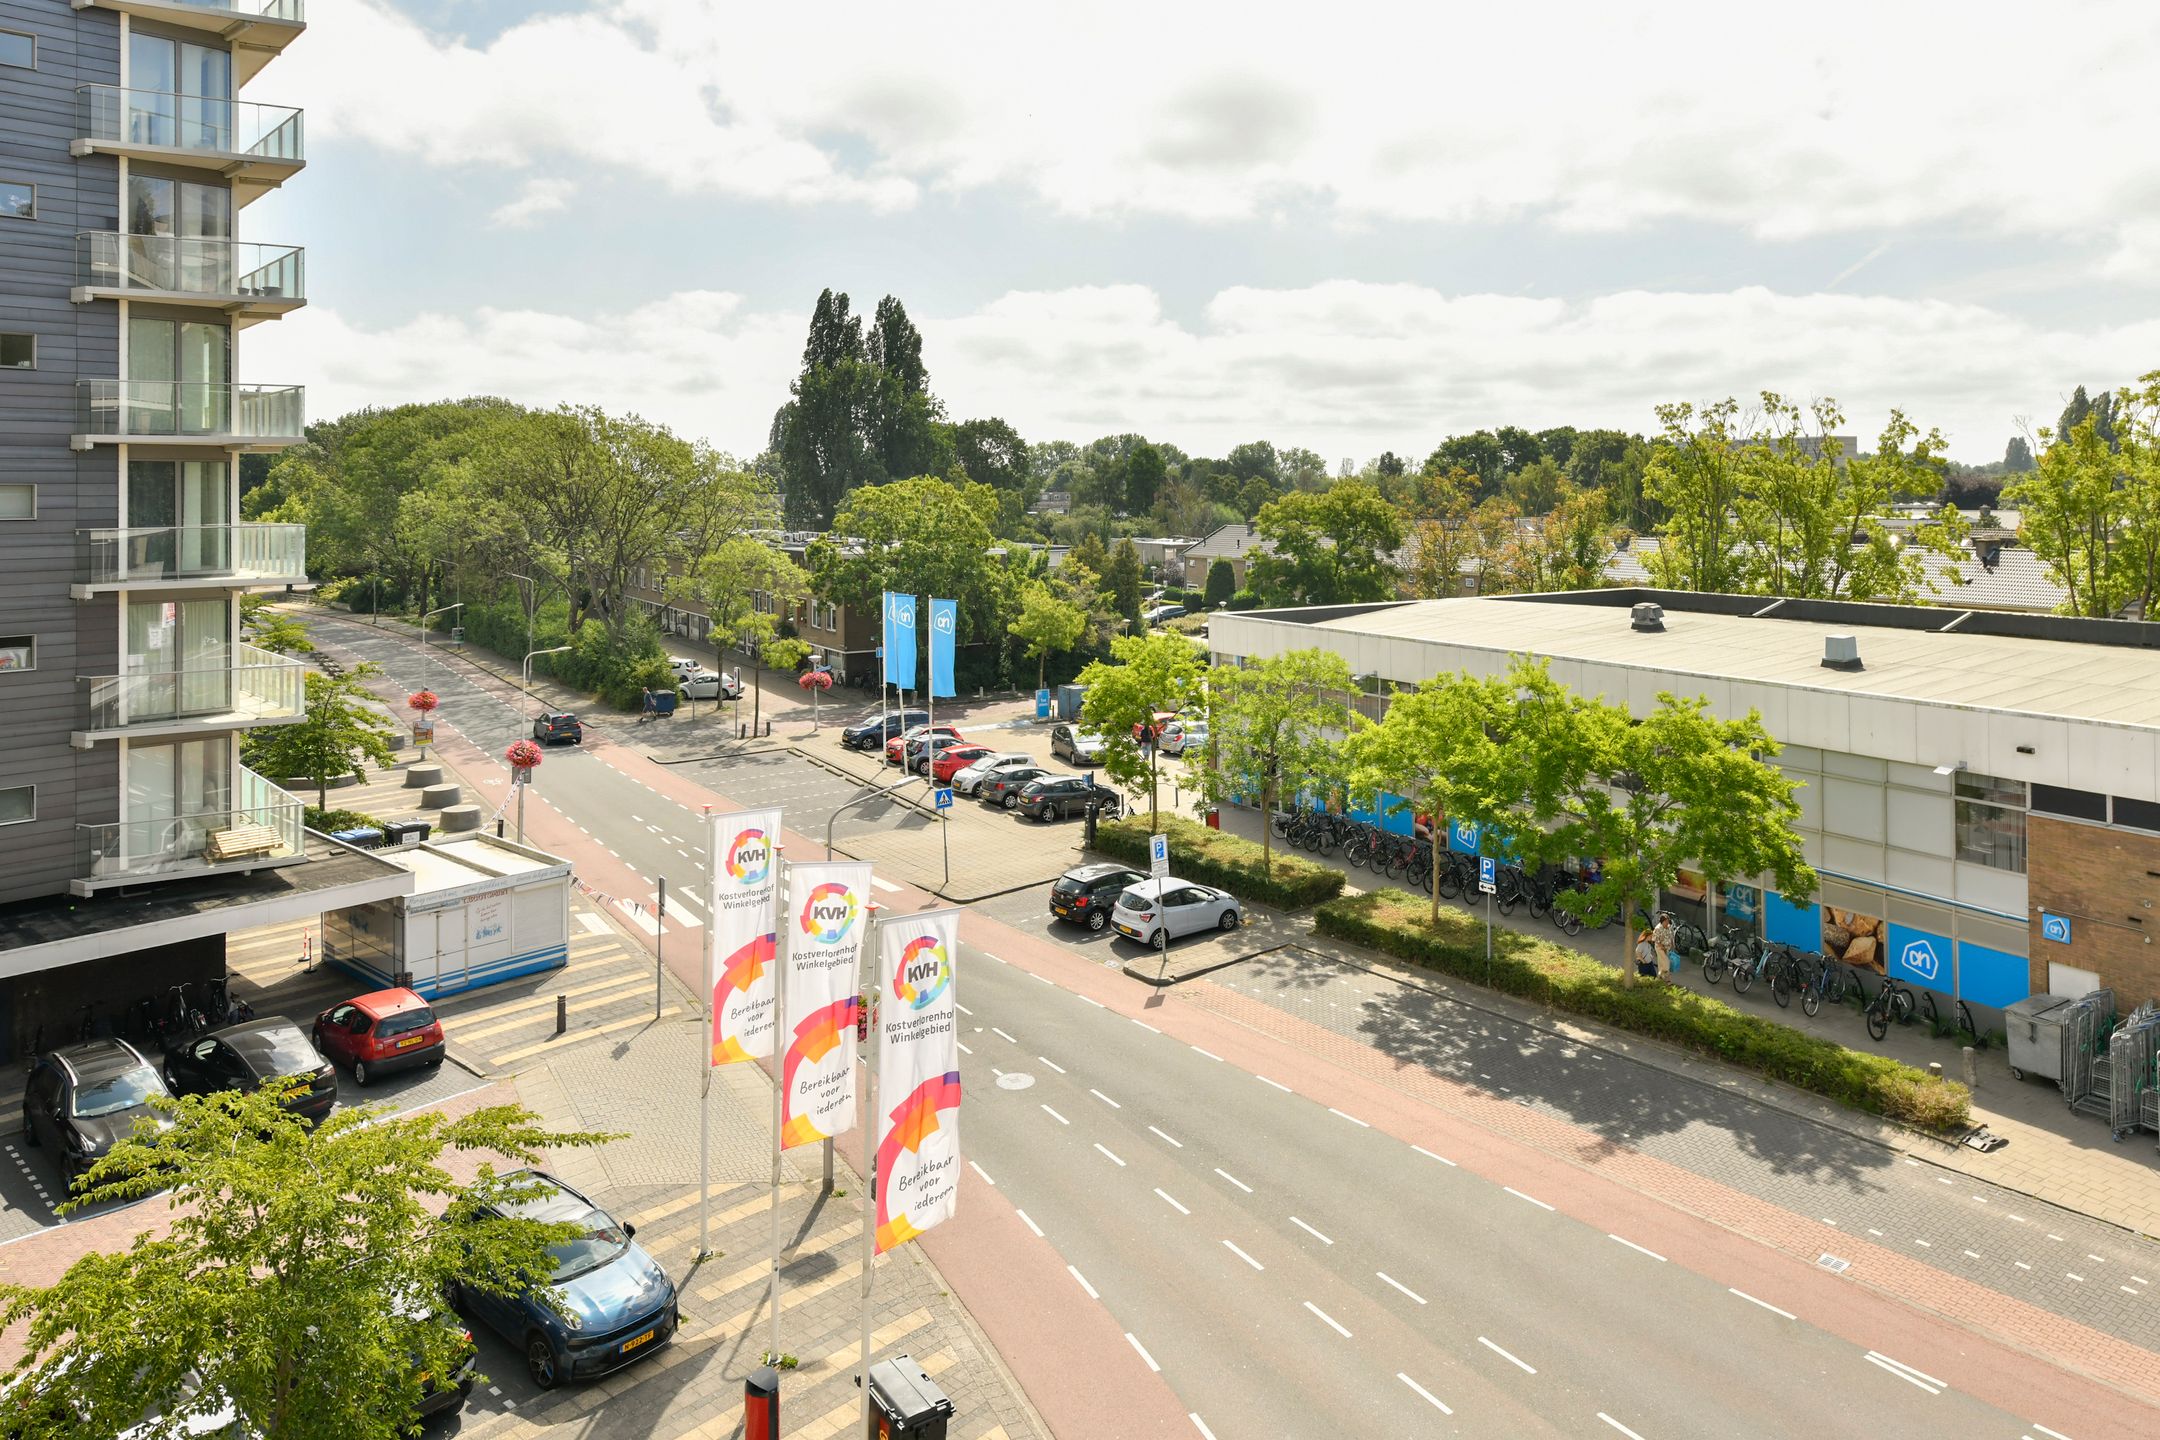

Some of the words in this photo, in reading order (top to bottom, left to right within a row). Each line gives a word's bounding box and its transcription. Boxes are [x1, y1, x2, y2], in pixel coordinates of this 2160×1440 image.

[738, 848, 766, 864] KVH
[1483, 859, 1492, 873] P
[813, 905, 848, 920] KVH
[791, 942, 858, 962] Kostverlorenhof
[795, 954, 854, 972] Winkelgebied
[907, 961, 938, 983] KVH
[747, 1012, 765, 1023] voor
[890, 1021, 951, 1045] Winkelgebied
[799, 1067, 850, 1095] Bereikbaar
[820, 1085, 841, 1098] voor
[898, 1155, 954, 1192] Bereikbaar
[919, 1176, 941, 1192] voor
